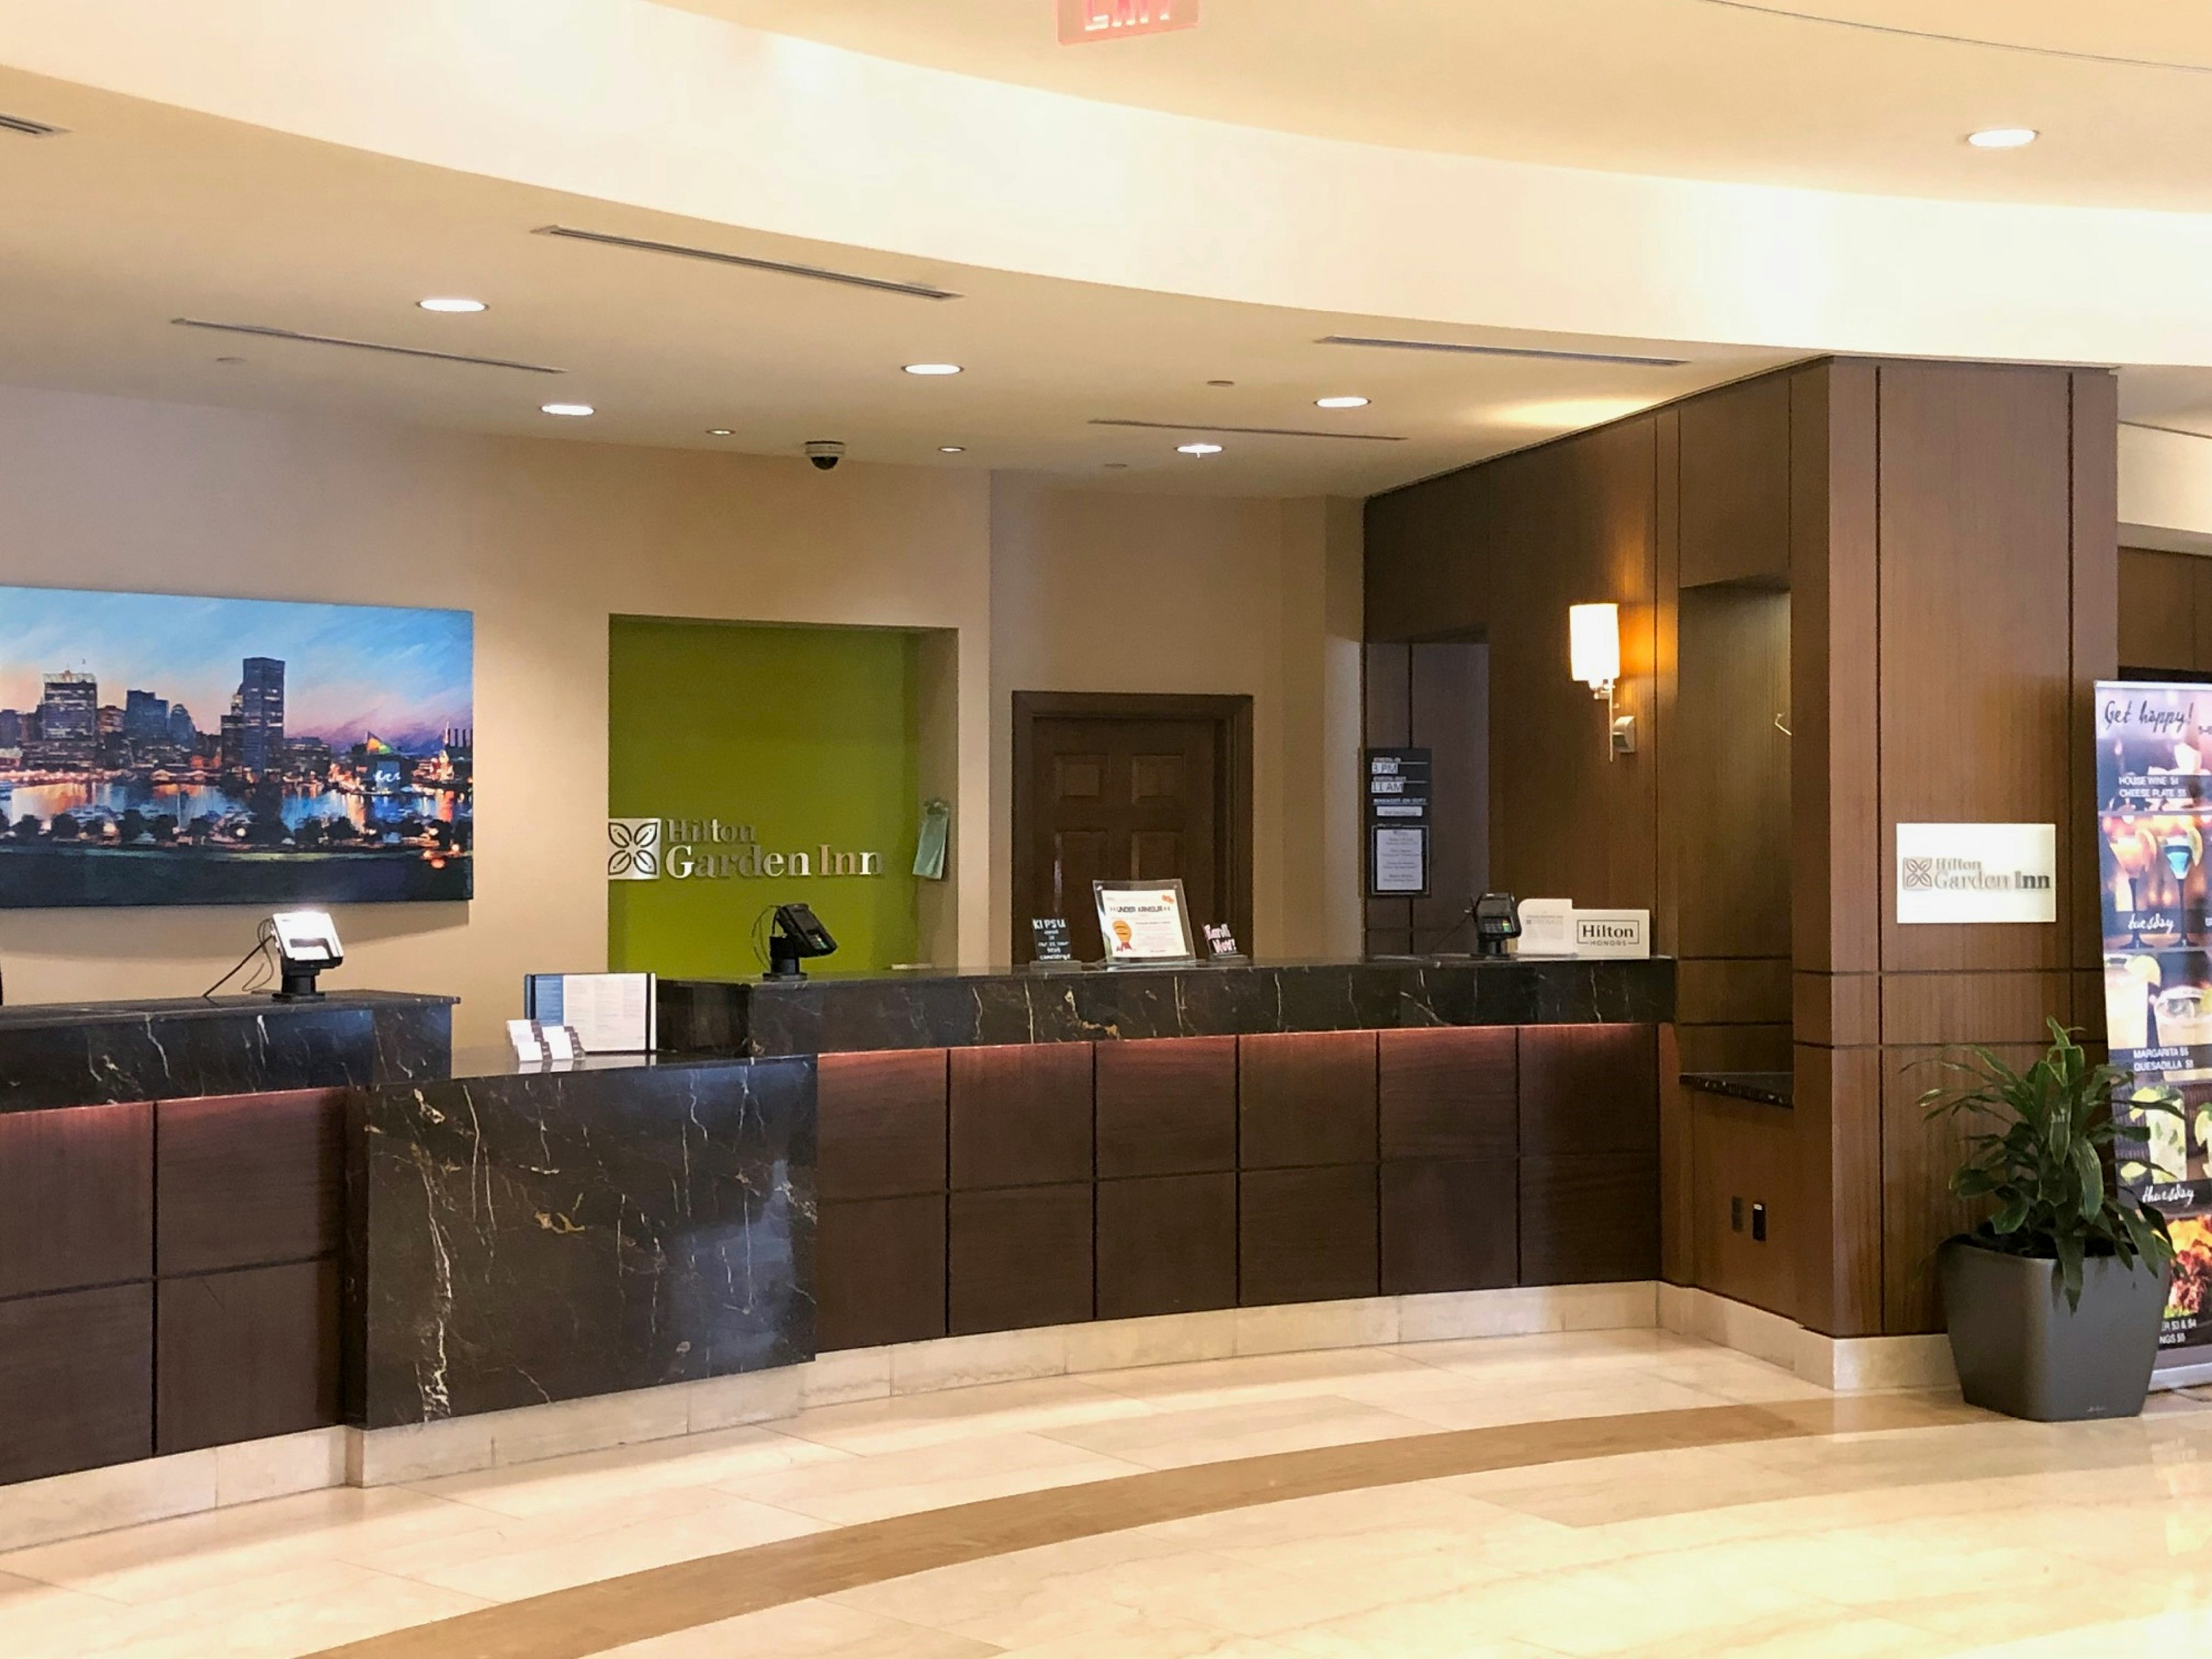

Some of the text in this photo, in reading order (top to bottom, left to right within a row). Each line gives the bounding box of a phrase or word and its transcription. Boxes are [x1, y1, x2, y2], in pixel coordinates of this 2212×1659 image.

[2104, 700, 2194, 733] Get happy!
[1381, 764, 1396, 773] PM
[2118, 776, 2146, 785] HOUSE
[2147, 776, 2167, 785] WINE
[2119, 788, 2151, 797] CHEESE
[2152, 788, 2174, 797] PLATE
[667, 818, 756, 843] Hilton
[665, 844, 884, 879] Garden Inn
[1936, 857, 1982, 870] Hilton
[1934, 870, 2051, 890] Garden Inn
[1582, 924, 1634, 938] Hilton
[2133, 1047, 2178, 1059] MARGARITA
[2133, 1059, 2183, 1072] QUESADILLA
[2142, 1183, 2195, 1208] thursday
